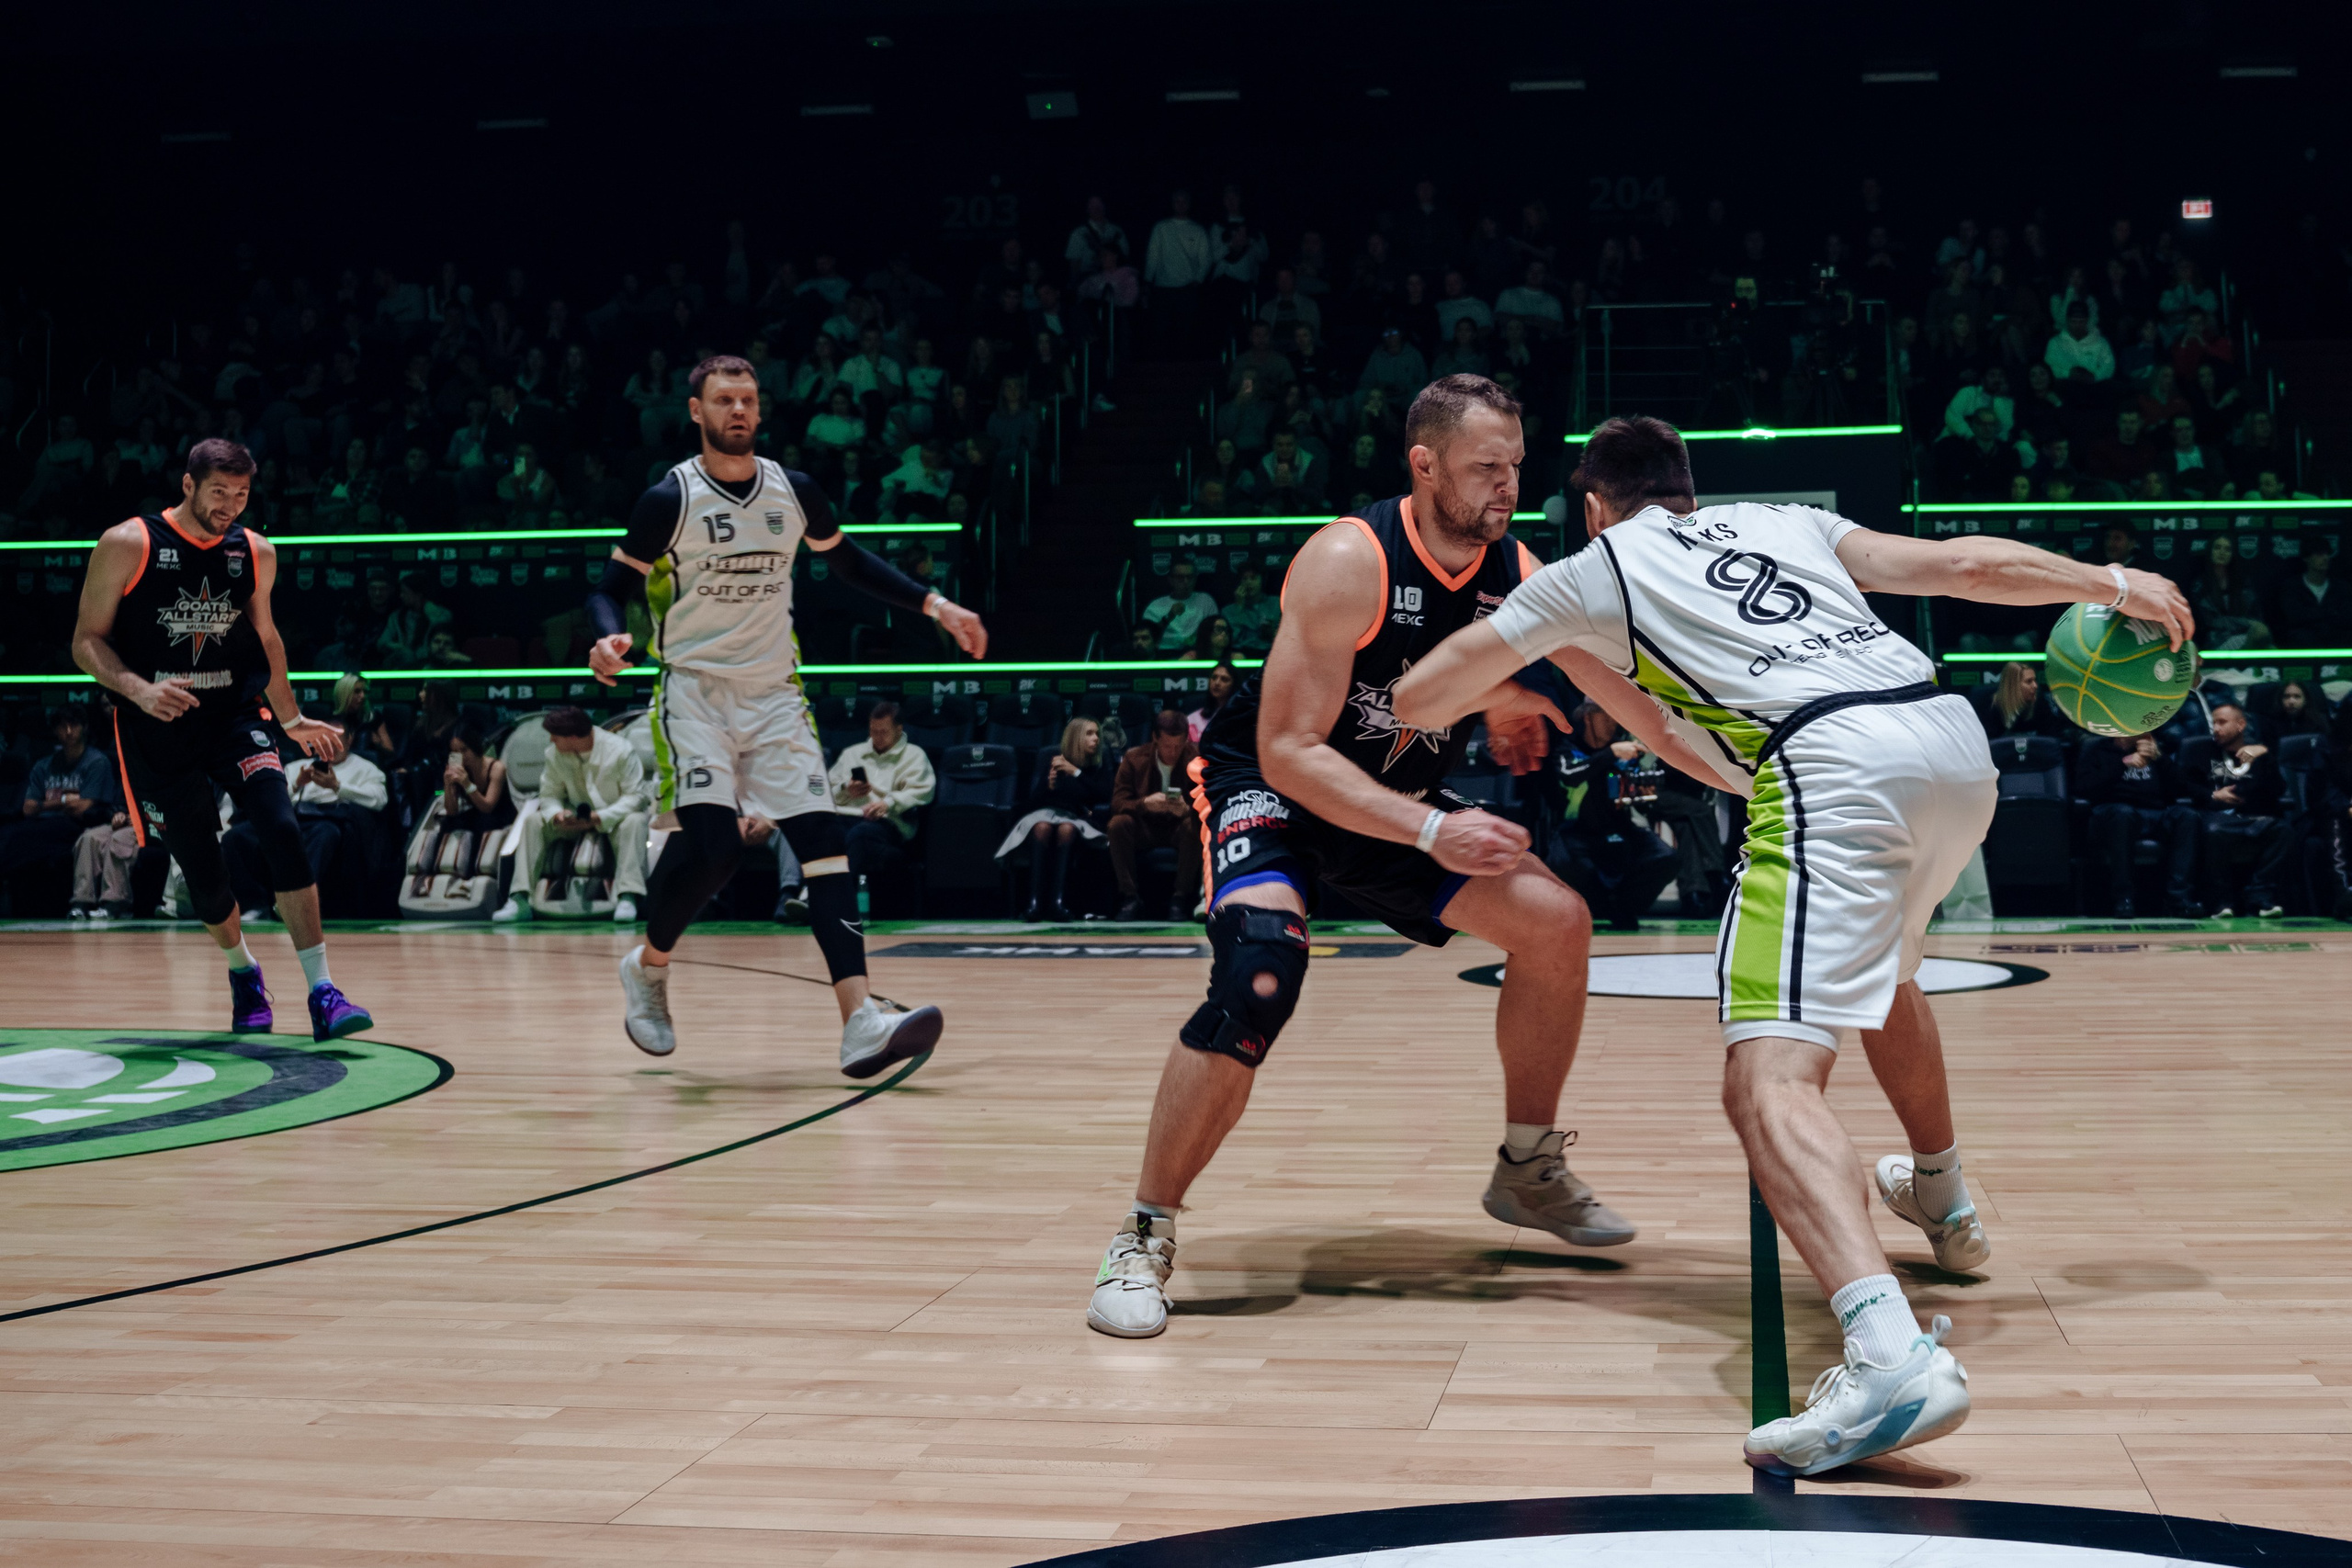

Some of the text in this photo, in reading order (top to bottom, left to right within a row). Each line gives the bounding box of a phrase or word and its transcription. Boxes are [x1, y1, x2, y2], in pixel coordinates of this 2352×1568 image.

[1589, 174, 1667, 212] 204
[942, 193, 1020, 229] 203
[702, 513, 735, 544] 15
[156, 562, 182, 571] MEXC
[159, 547, 180, 562] 21
[697, 585, 733, 596] OUT
[738, 585, 760, 596] OF
[1393, 584, 1423, 613] 10
[163, 611, 236, 623] ALLSTARS
[177, 601, 229, 612] GOATS
[1836, 621, 1890, 646] REC
[1216, 836, 1251, 874] 10
